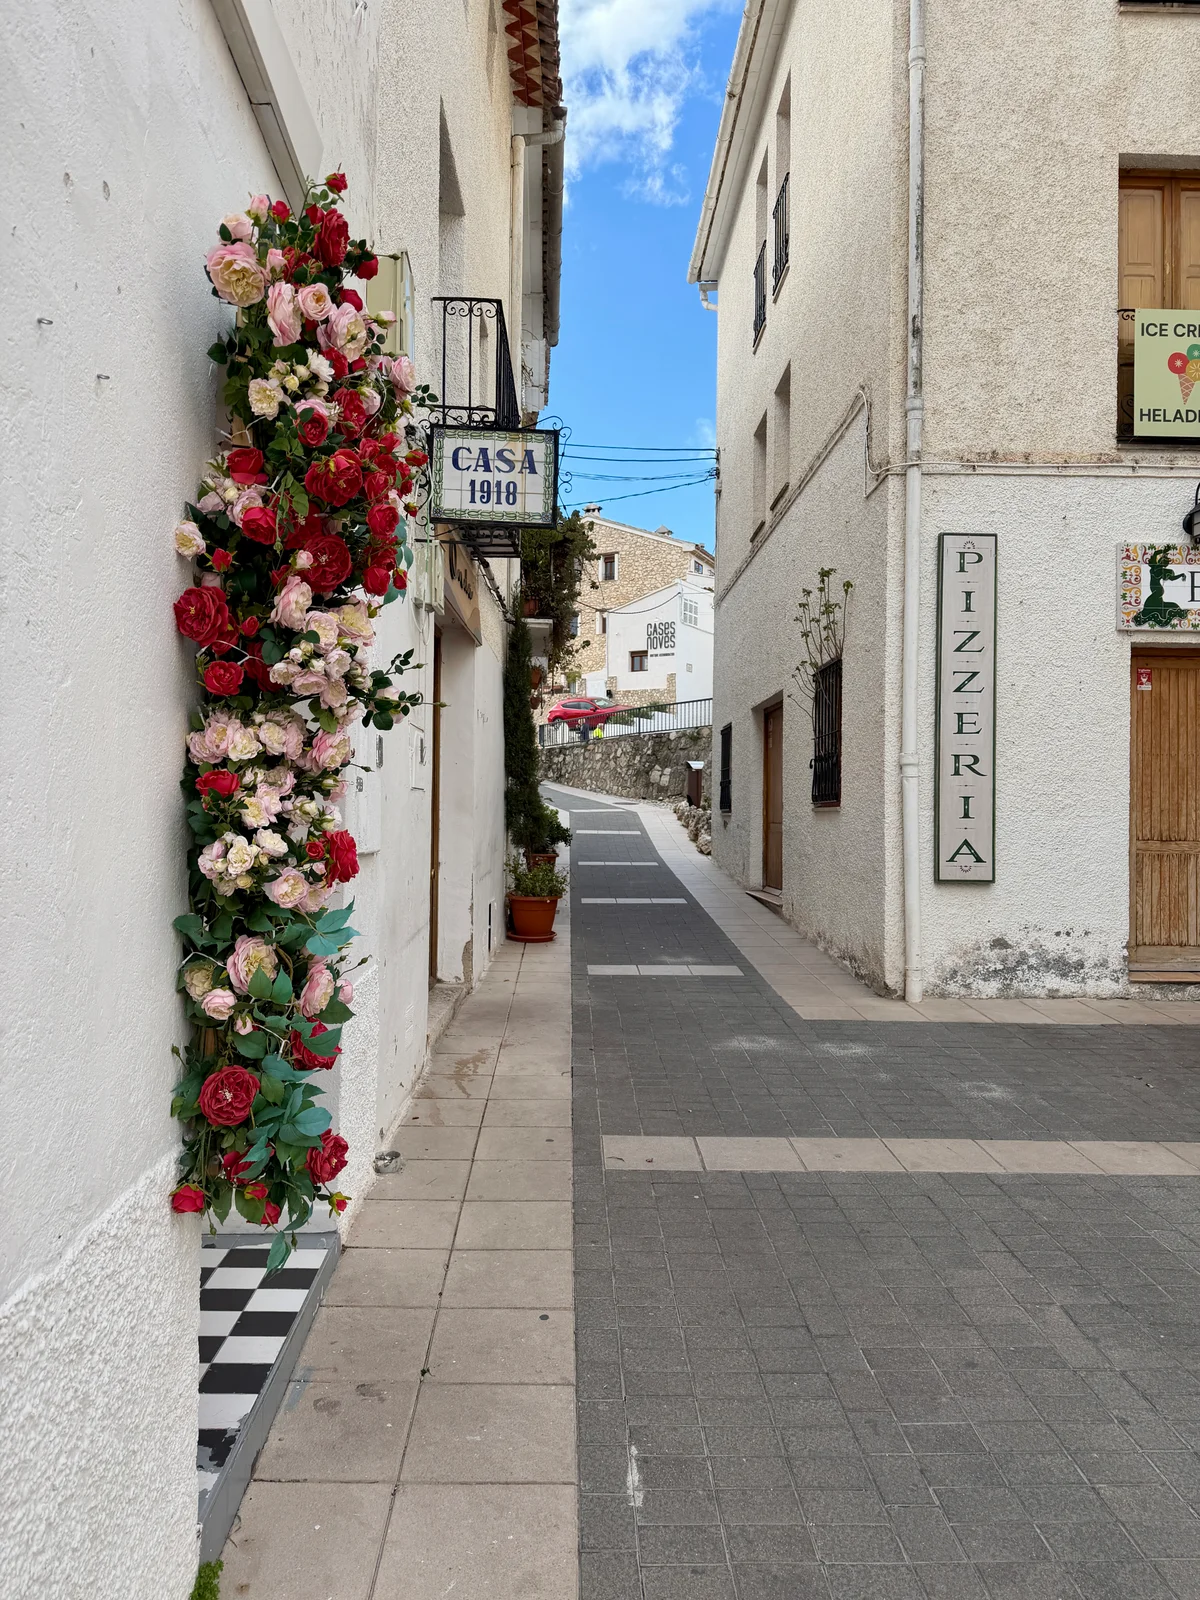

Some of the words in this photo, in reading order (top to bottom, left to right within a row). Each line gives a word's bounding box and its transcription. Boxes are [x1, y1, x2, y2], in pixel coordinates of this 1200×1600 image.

[1141, 323, 1168, 337] ICE
[1173, 323, 1200, 338] CR
[1139, 408, 1200, 423] HELAD
[451, 446, 538, 474] CASA
[468, 479, 518, 506] 1918
[946, 551, 988, 864] PIZZERIA
